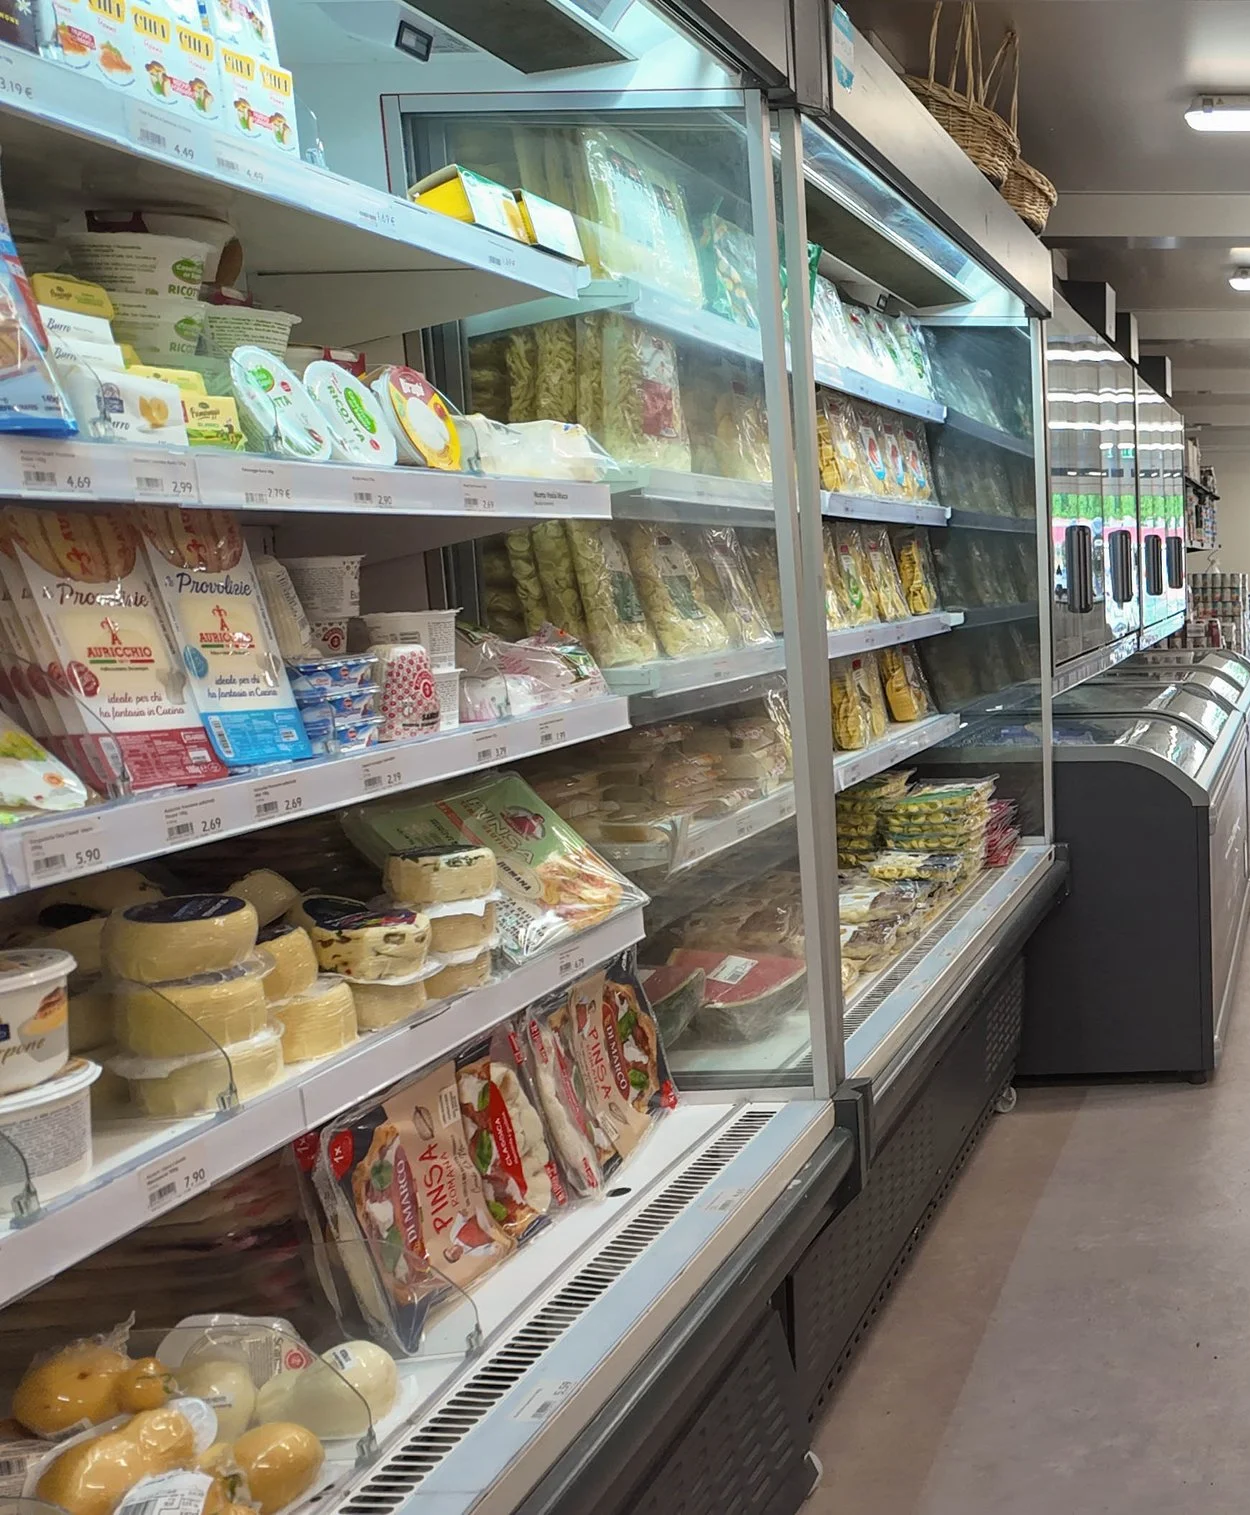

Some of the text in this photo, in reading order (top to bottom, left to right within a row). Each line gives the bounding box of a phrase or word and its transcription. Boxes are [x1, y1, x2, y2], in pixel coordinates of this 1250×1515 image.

[47, 317, 72, 332] Burro
[327, 385, 365, 442] RICOTTA
[176, 572, 252, 597] Provolizie
[87, 647, 153, 658] AURICCHIO
[99, 705, 185, 720] ha fantasia in Cucina
[107, 691, 163, 706] ideale per chi
[588, 1028, 612, 1099] PINSA
[609, 1040, 629, 1091] MARCO
[396, 1159, 414, 1223] MARCO
[418, 1142, 454, 1235] PINSA
